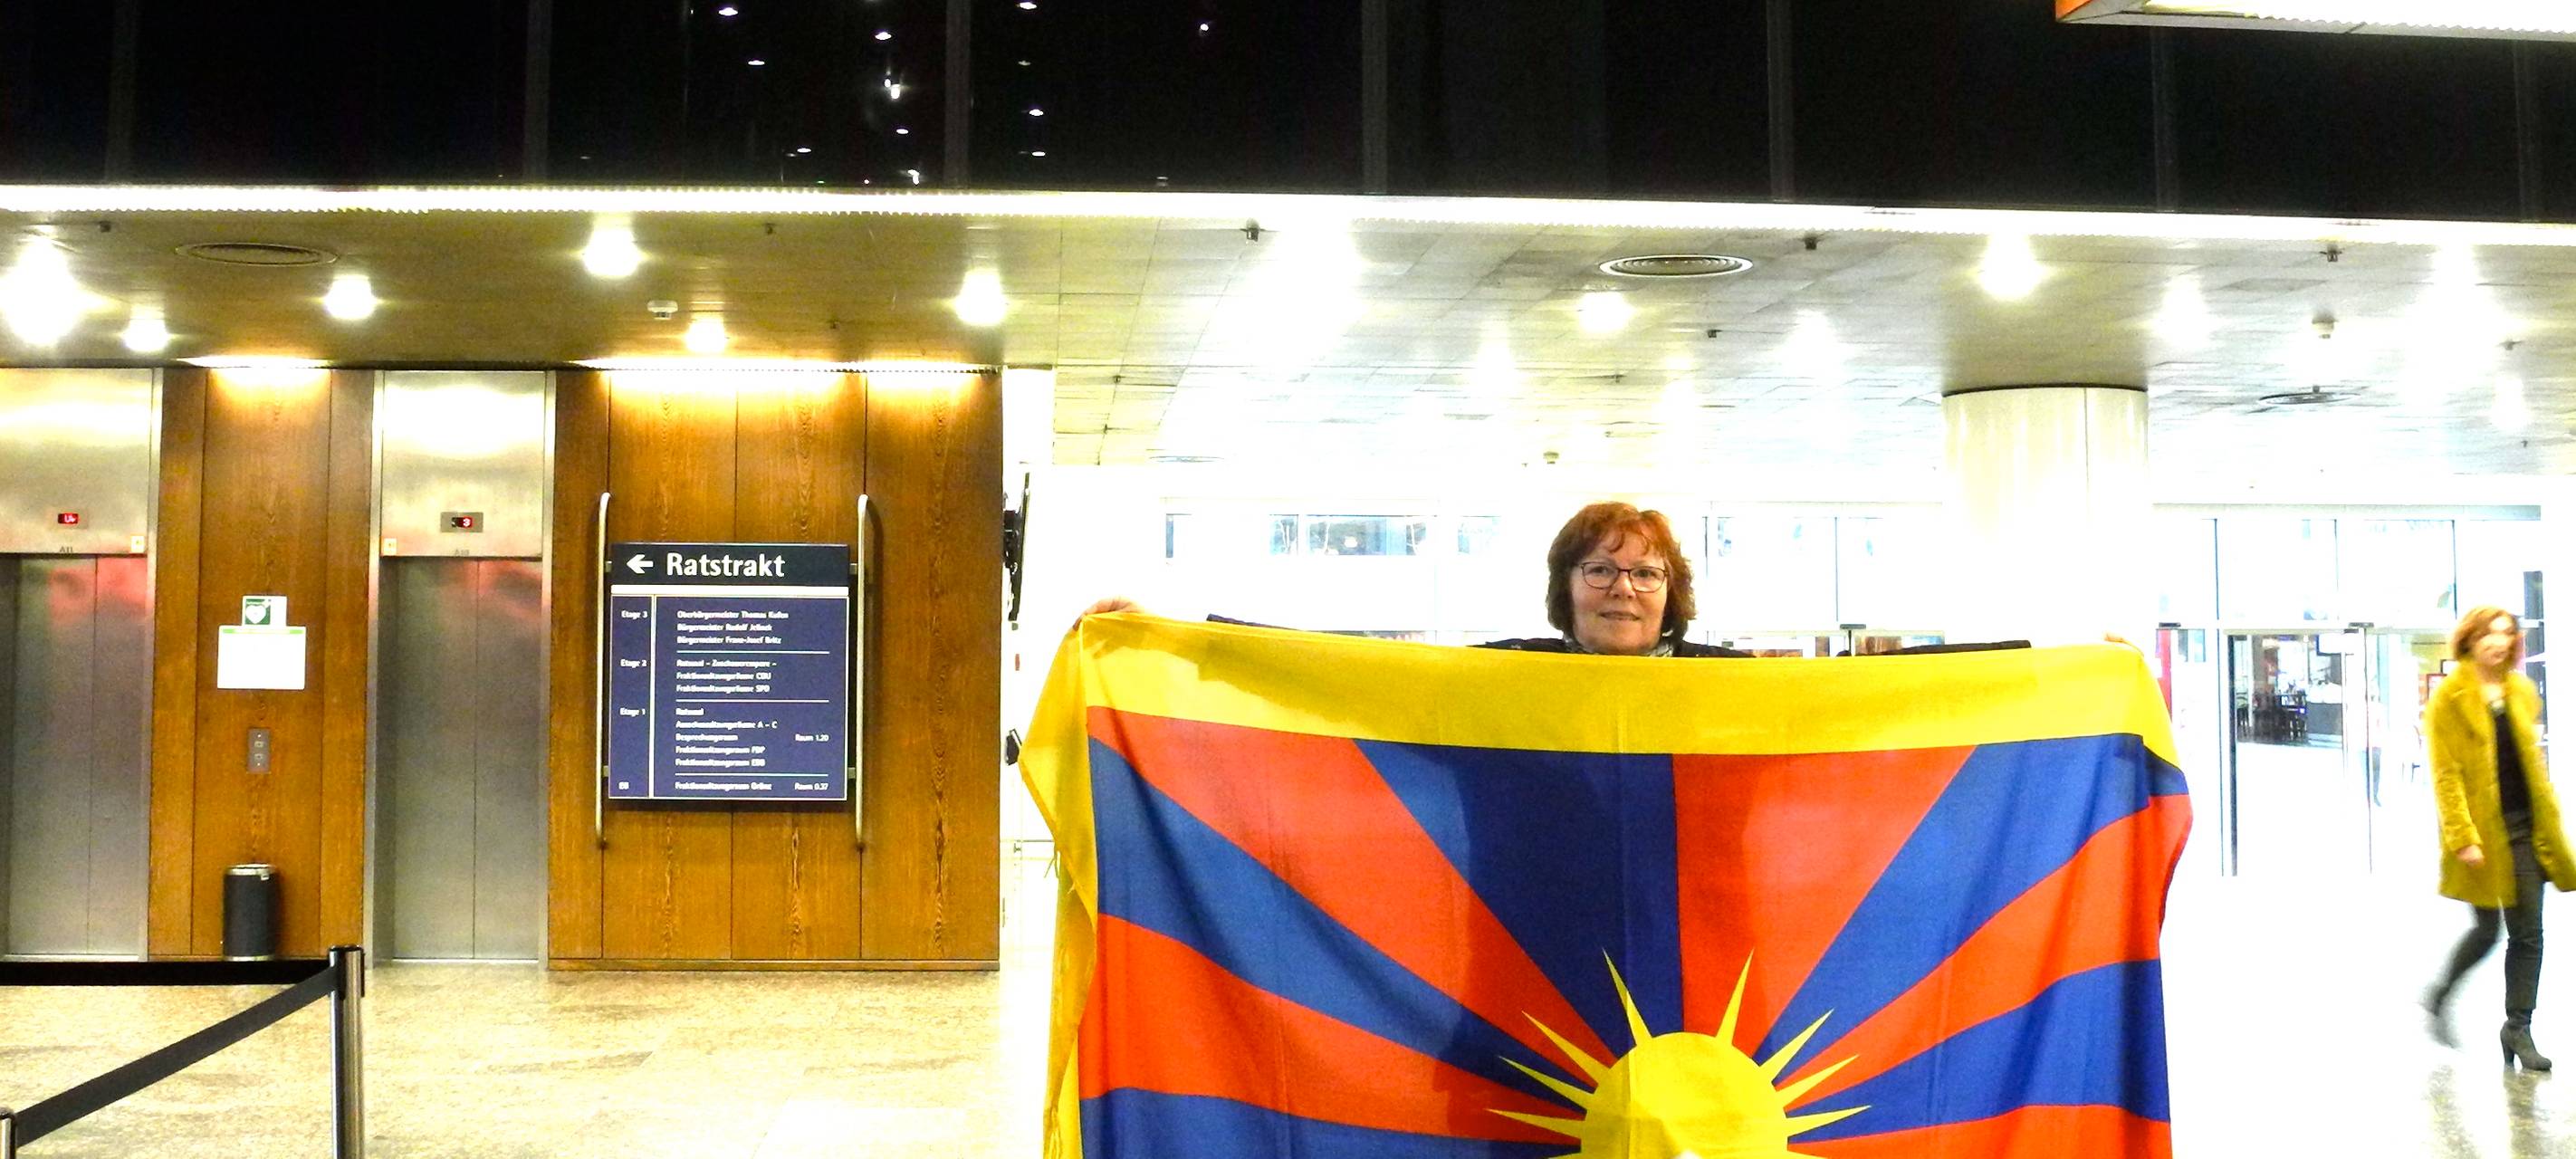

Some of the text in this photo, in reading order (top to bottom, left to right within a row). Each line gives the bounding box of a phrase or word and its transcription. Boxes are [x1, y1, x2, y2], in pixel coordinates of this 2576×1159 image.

[666, 551, 786, 578] Ratstrakt
[621, 610, 648, 620] Etage 3
[620, 659, 647, 669] Etage 2
